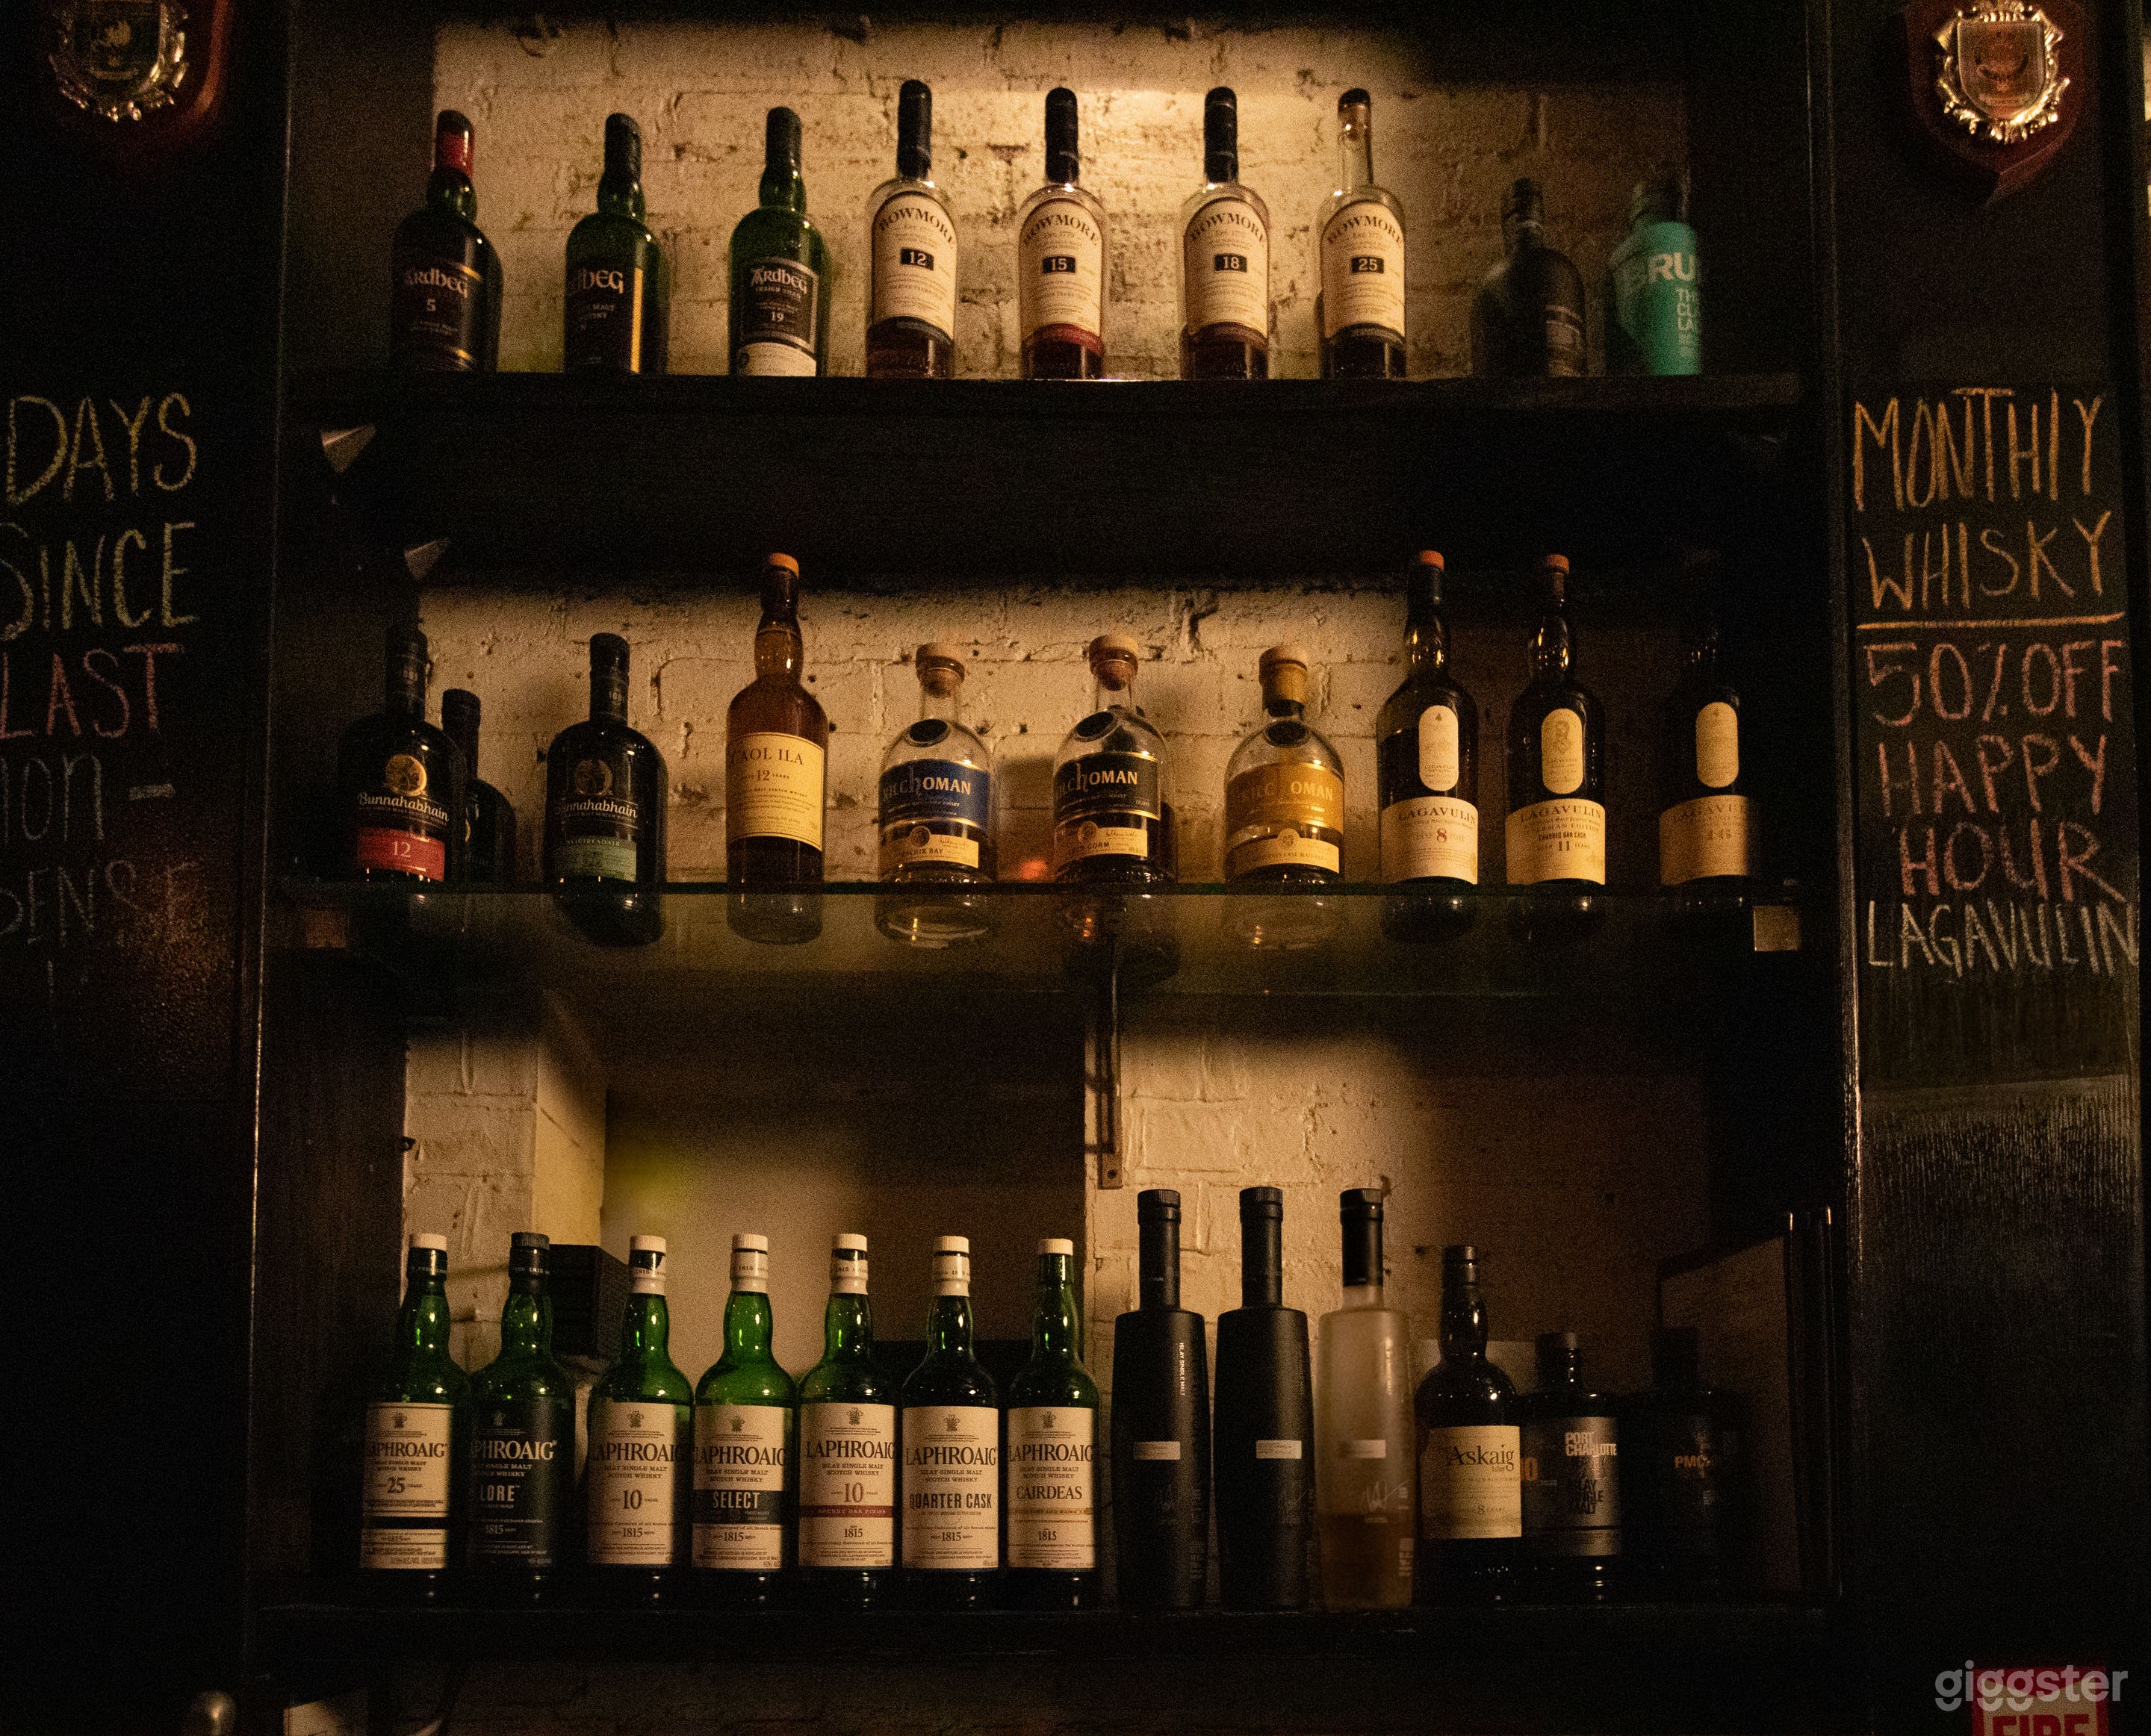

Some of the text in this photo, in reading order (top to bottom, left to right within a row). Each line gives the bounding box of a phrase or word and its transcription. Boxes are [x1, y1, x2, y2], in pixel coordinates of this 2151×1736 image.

[910, 252, 926, 266] 12
[1052, 258, 1067, 271] 15
[1223, 257, 1240, 270] 18
[1358, 258, 1379, 272] 25
[426, 298, 436, 311] 5
[771, 311, 784, 323] 19
[6, 393, 197, 505] DAYS
[1863, 510, 2112, 611] WHISKY
[0, 521, 199, 641] SINCE
[0, 643, 181, 739] LAST
[778, 748, 804, 765] ILA
[757, 770, 770, 781] 12
[1878, 733, 2106, 818] HAPPY
[358, 791, 449, 821] Bunnahabhain
[1521, 804, 1602, 823] LAGAVULIN
[1398, 806, 1477, 824] LAGAVULIN
[1436, 828, 1447, 843] 8
[392, 841, 412, 858] 12
[1558, 841, 1571, 851] 11
[1893, 818, 2127, 902] HOUR
[1867, 898, 2141, 978] LAGAVULIN
[906, 1446, 996, 1466] LAPHROAIG
[1444, 1444, 1515, 1472] Askaig
[388, 1477, 406, 1493] 25
[844, 1482, 864, 1503] 10
[623, 1490, 643, 1509] 10
[713, 1491, 760, 1509] SELECT
[909, 1493, 993, 1510] QUARTER CASK
[1477, 1505, 1486, 1515] 8
[622, 1528, 643, 1537] 1815
[723, 1532, 744, 1542] 1815
[844, 1528, 863, 1538] 1815
[941, 1532, 962, 1542] 1815
[1038, 1531, 1057, 1540] 1815
